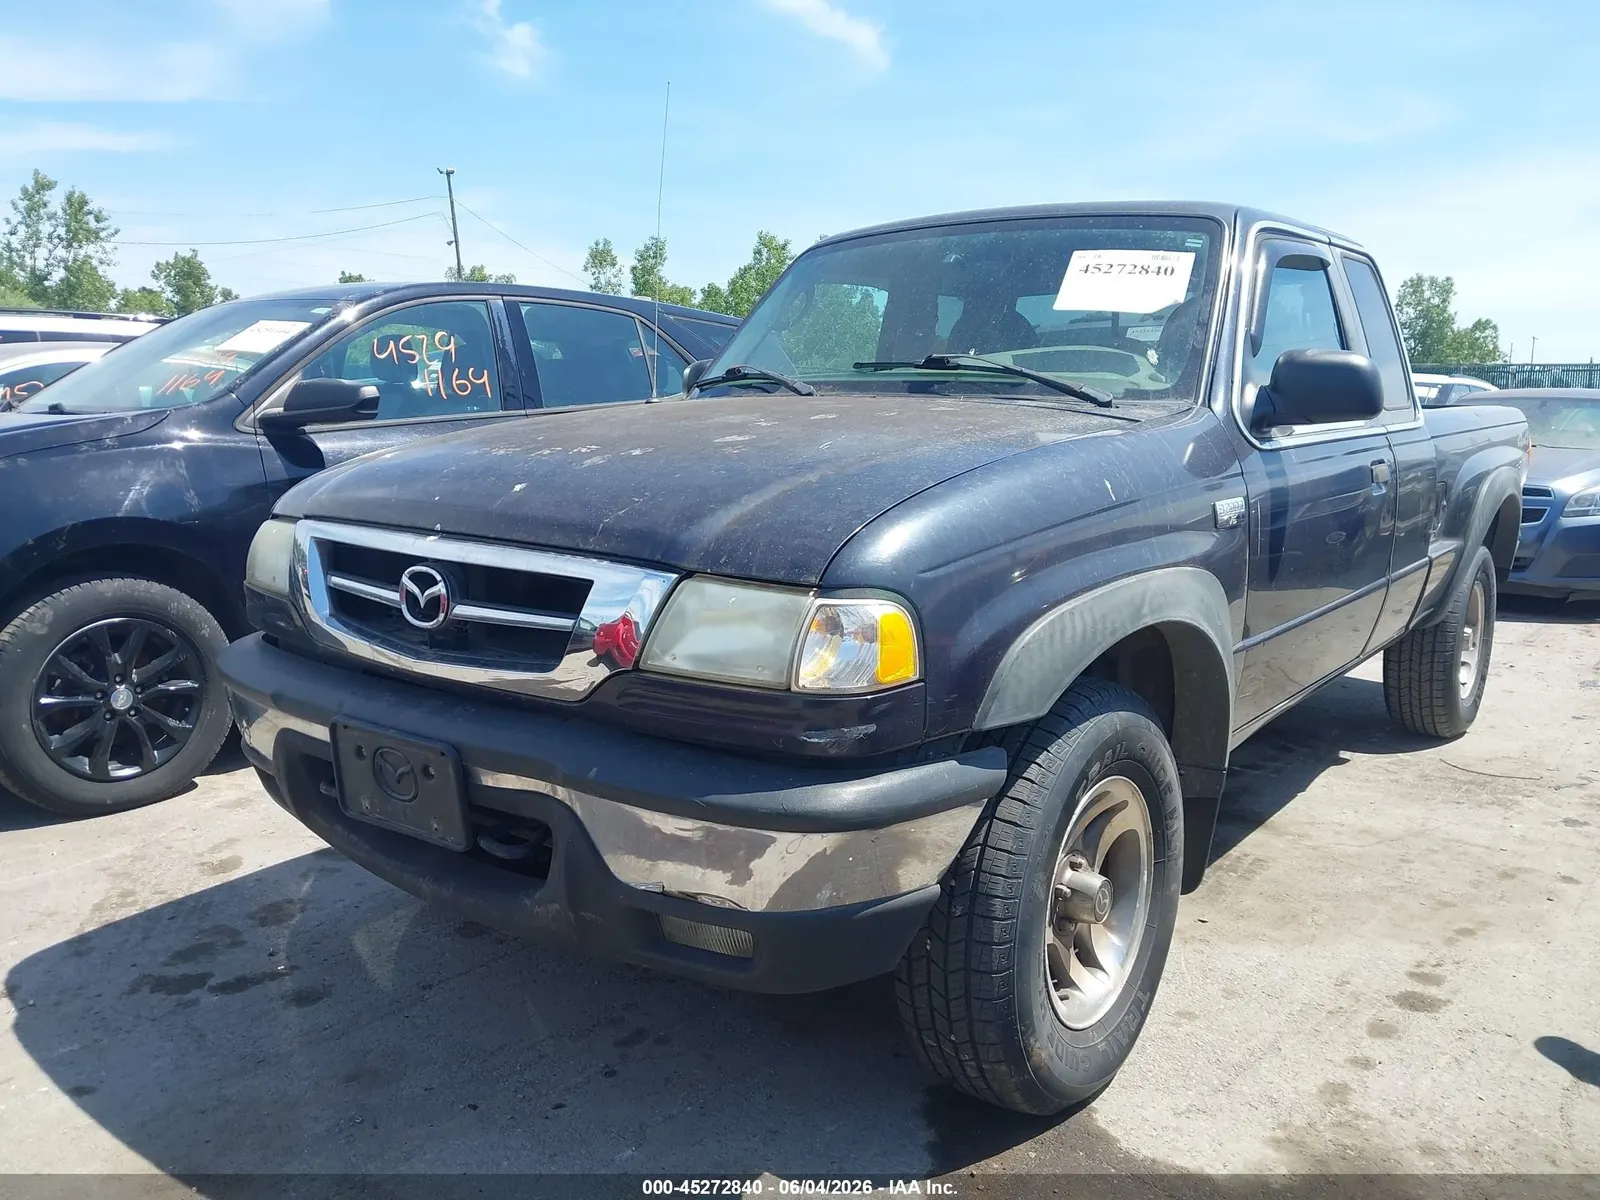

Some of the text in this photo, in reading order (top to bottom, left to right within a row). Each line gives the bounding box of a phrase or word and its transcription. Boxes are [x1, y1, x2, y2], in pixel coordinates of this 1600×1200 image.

[1078, 262, 1176, 278] 45272840
[373, 331, 456, 365] 4529
[423, 367, 492, 400] 1164
[1136, 742, 1174, 797] GUIDE
[1097, 990, 1152, 1062] TRAIL
